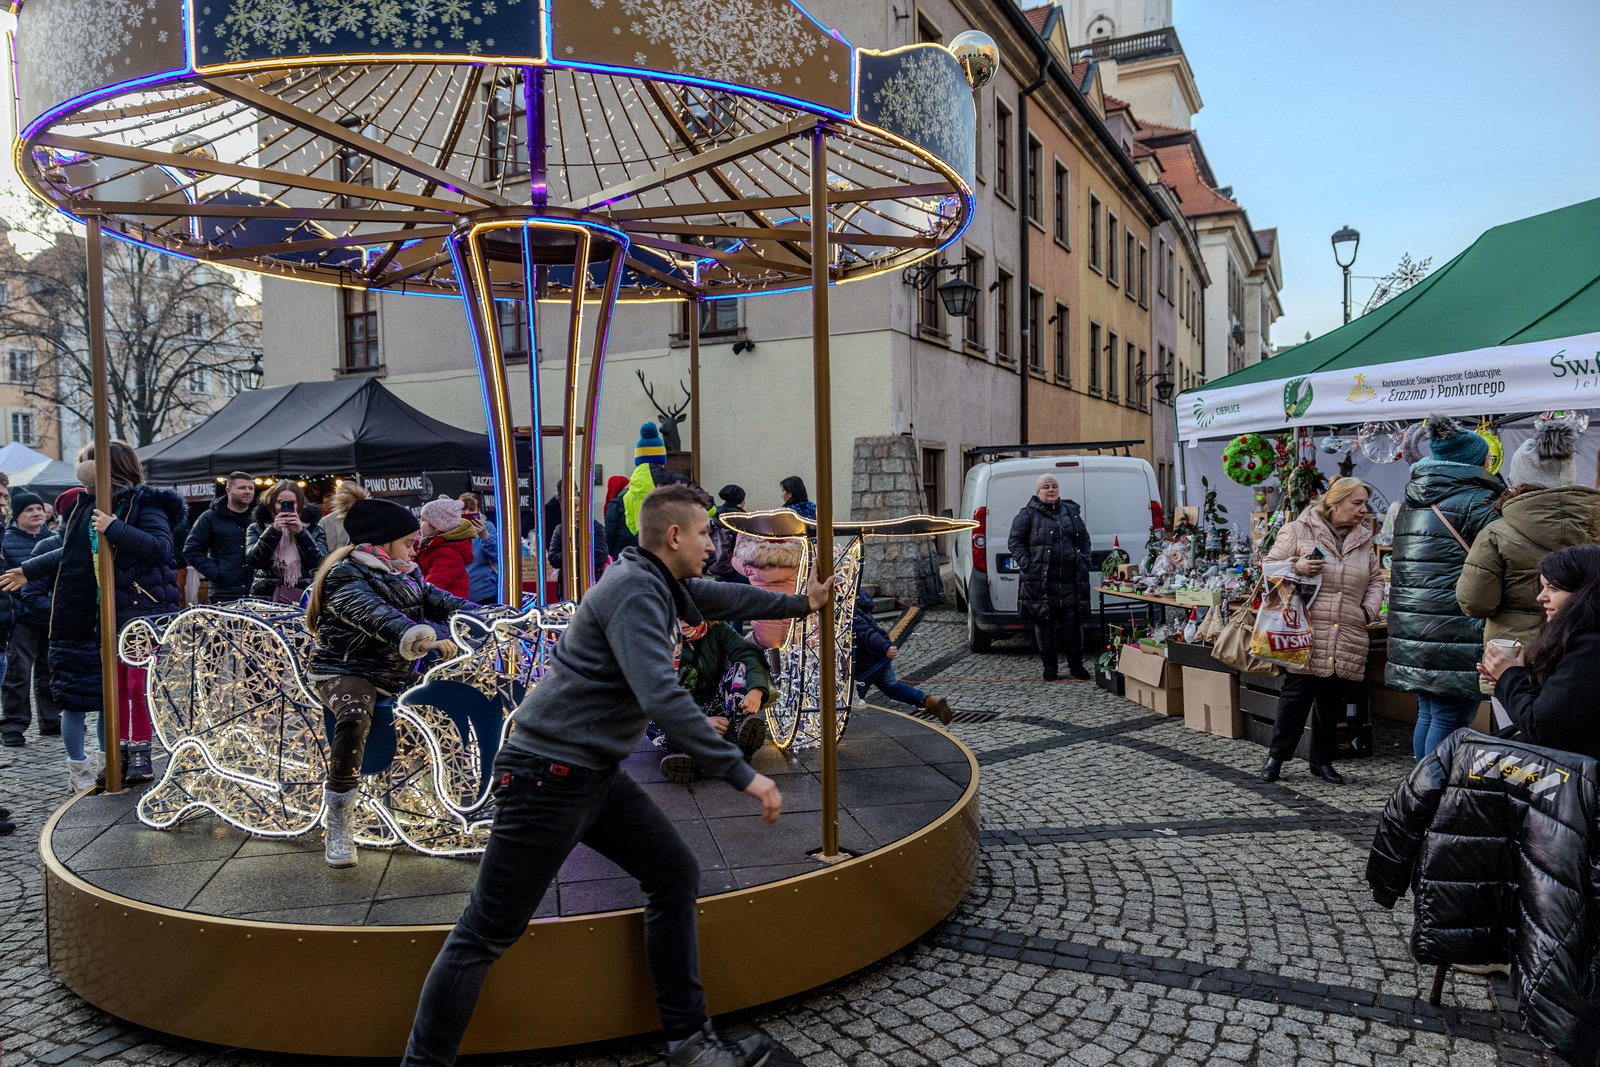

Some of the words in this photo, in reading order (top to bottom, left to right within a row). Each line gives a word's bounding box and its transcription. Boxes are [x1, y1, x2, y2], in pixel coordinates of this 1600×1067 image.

[1417, 372, 1463, 385] Stowarzyszenie
[1464, 367, 1502, 380] Edukacyjne
[1388, 387, 1427, 402] Erazma
[1437, 380, 1506, 398] Pankracego
[191, 483, 215, 496] GRZANE
[364, 479, 387, 492] PIWO
[388, 476, 423, 490] GRZANE
